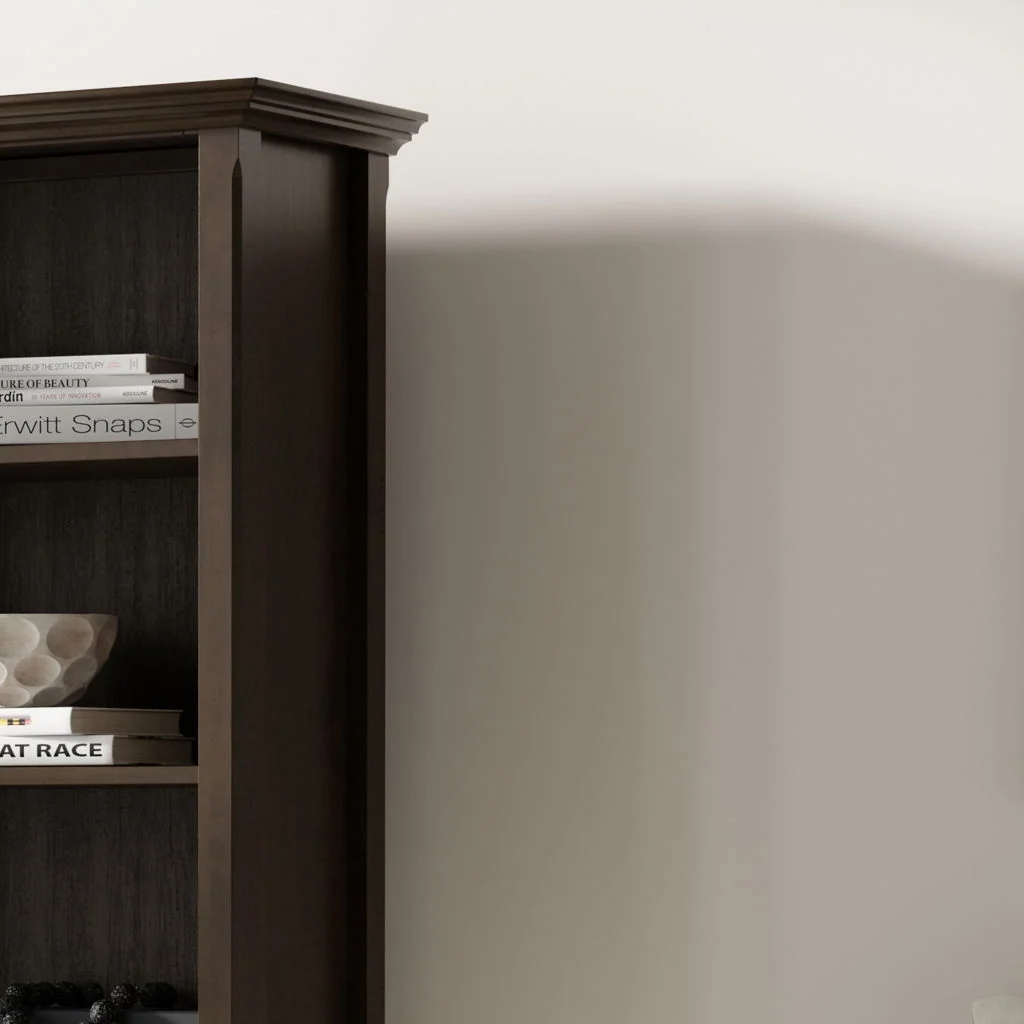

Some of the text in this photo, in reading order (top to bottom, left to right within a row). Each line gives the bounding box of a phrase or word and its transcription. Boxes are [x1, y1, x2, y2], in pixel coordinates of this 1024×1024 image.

[42, 363, 55, 371] THE
[73, 361, 105, 370] CENTURY
[26, 379, 42, 389] OF
[44, 378, 90, 388] BEAUTY
[72, 414, 162, 437] Snaps
[36, 743, 103, 757] RACE
